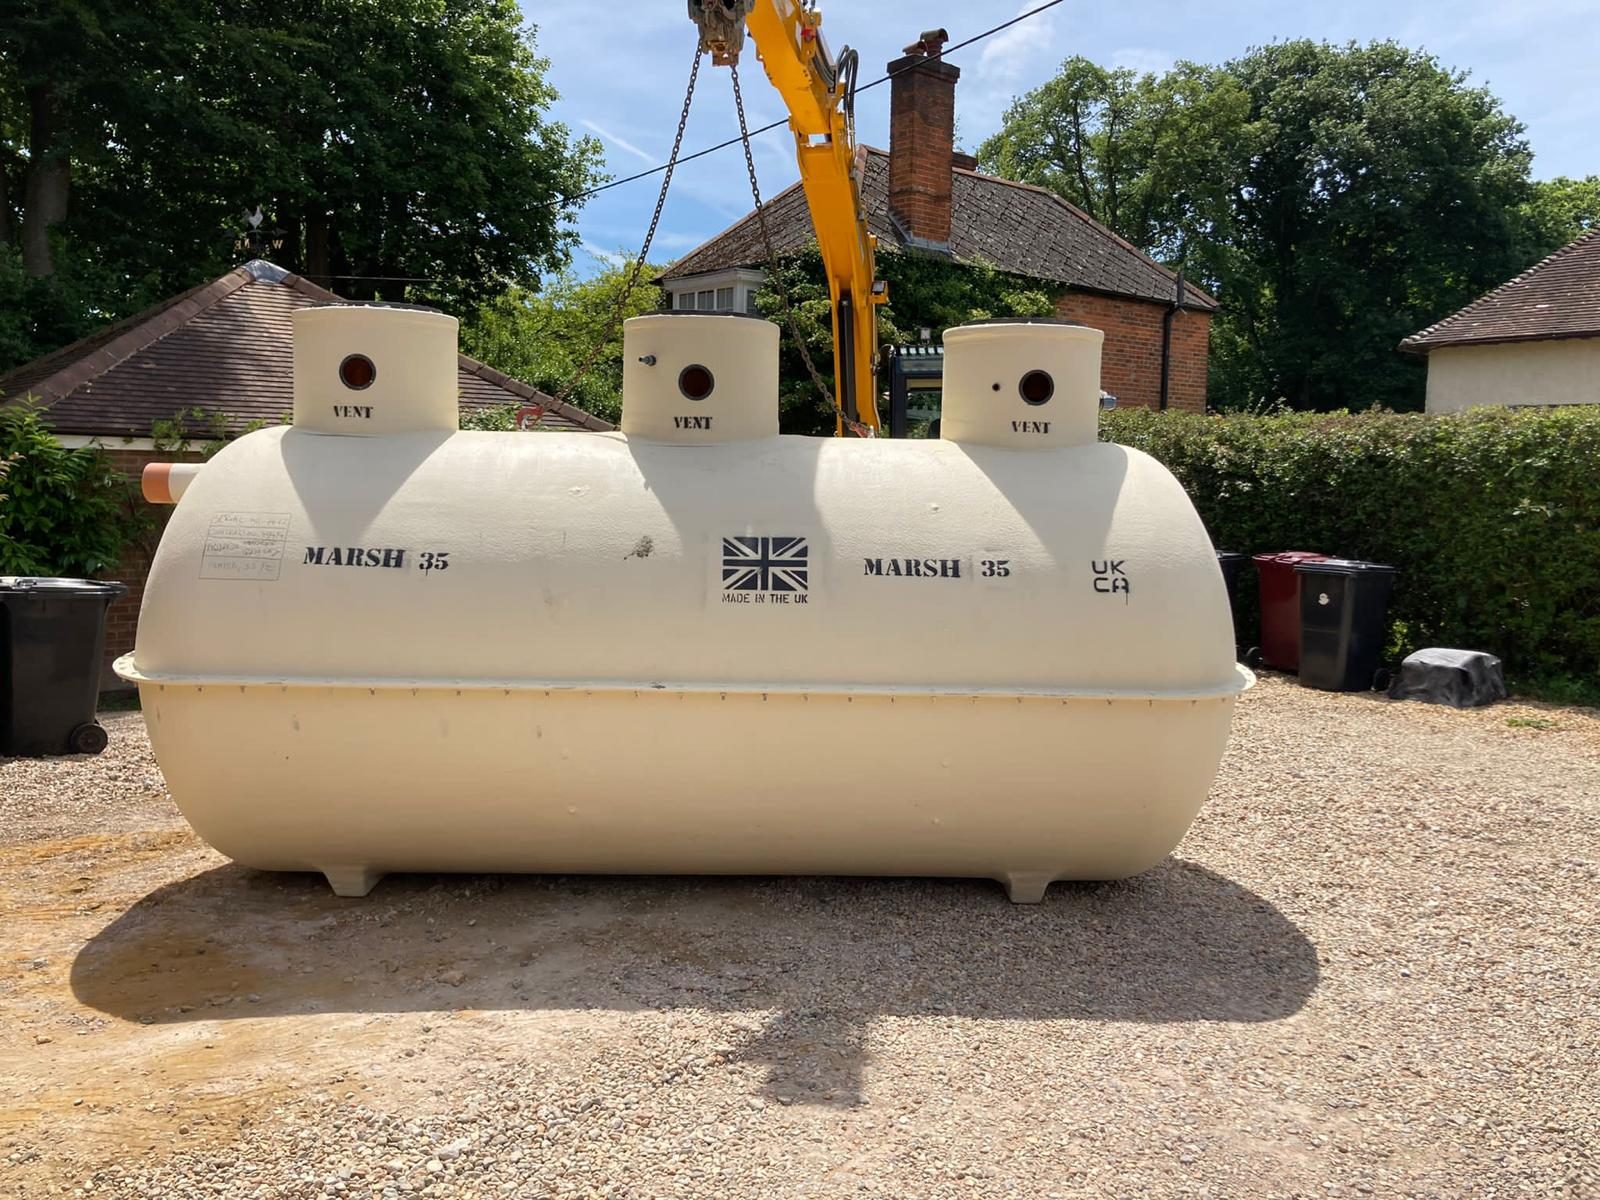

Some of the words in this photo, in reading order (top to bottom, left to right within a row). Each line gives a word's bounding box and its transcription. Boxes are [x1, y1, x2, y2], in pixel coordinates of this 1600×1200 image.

[333, 405, 374, 419] VENT
[673, 416, 714, 430] VENT
[1011, 420, 1051, 434] VENT
[303, 546, 406, 569] MARSH
[418, 552, 449, 570] 35
[863, 558, 961, 578] MARSH
[980, 560, 1010, 577] 35
[1091, 560, 1126, 576] UK
[1093, 577, 1130, 593] CA
[722, 593, 751, 604] MADE
[755, 593, 765, 604] IN
[769, 593, 790, 604] THE
[794, 593, 809, 604] UK
